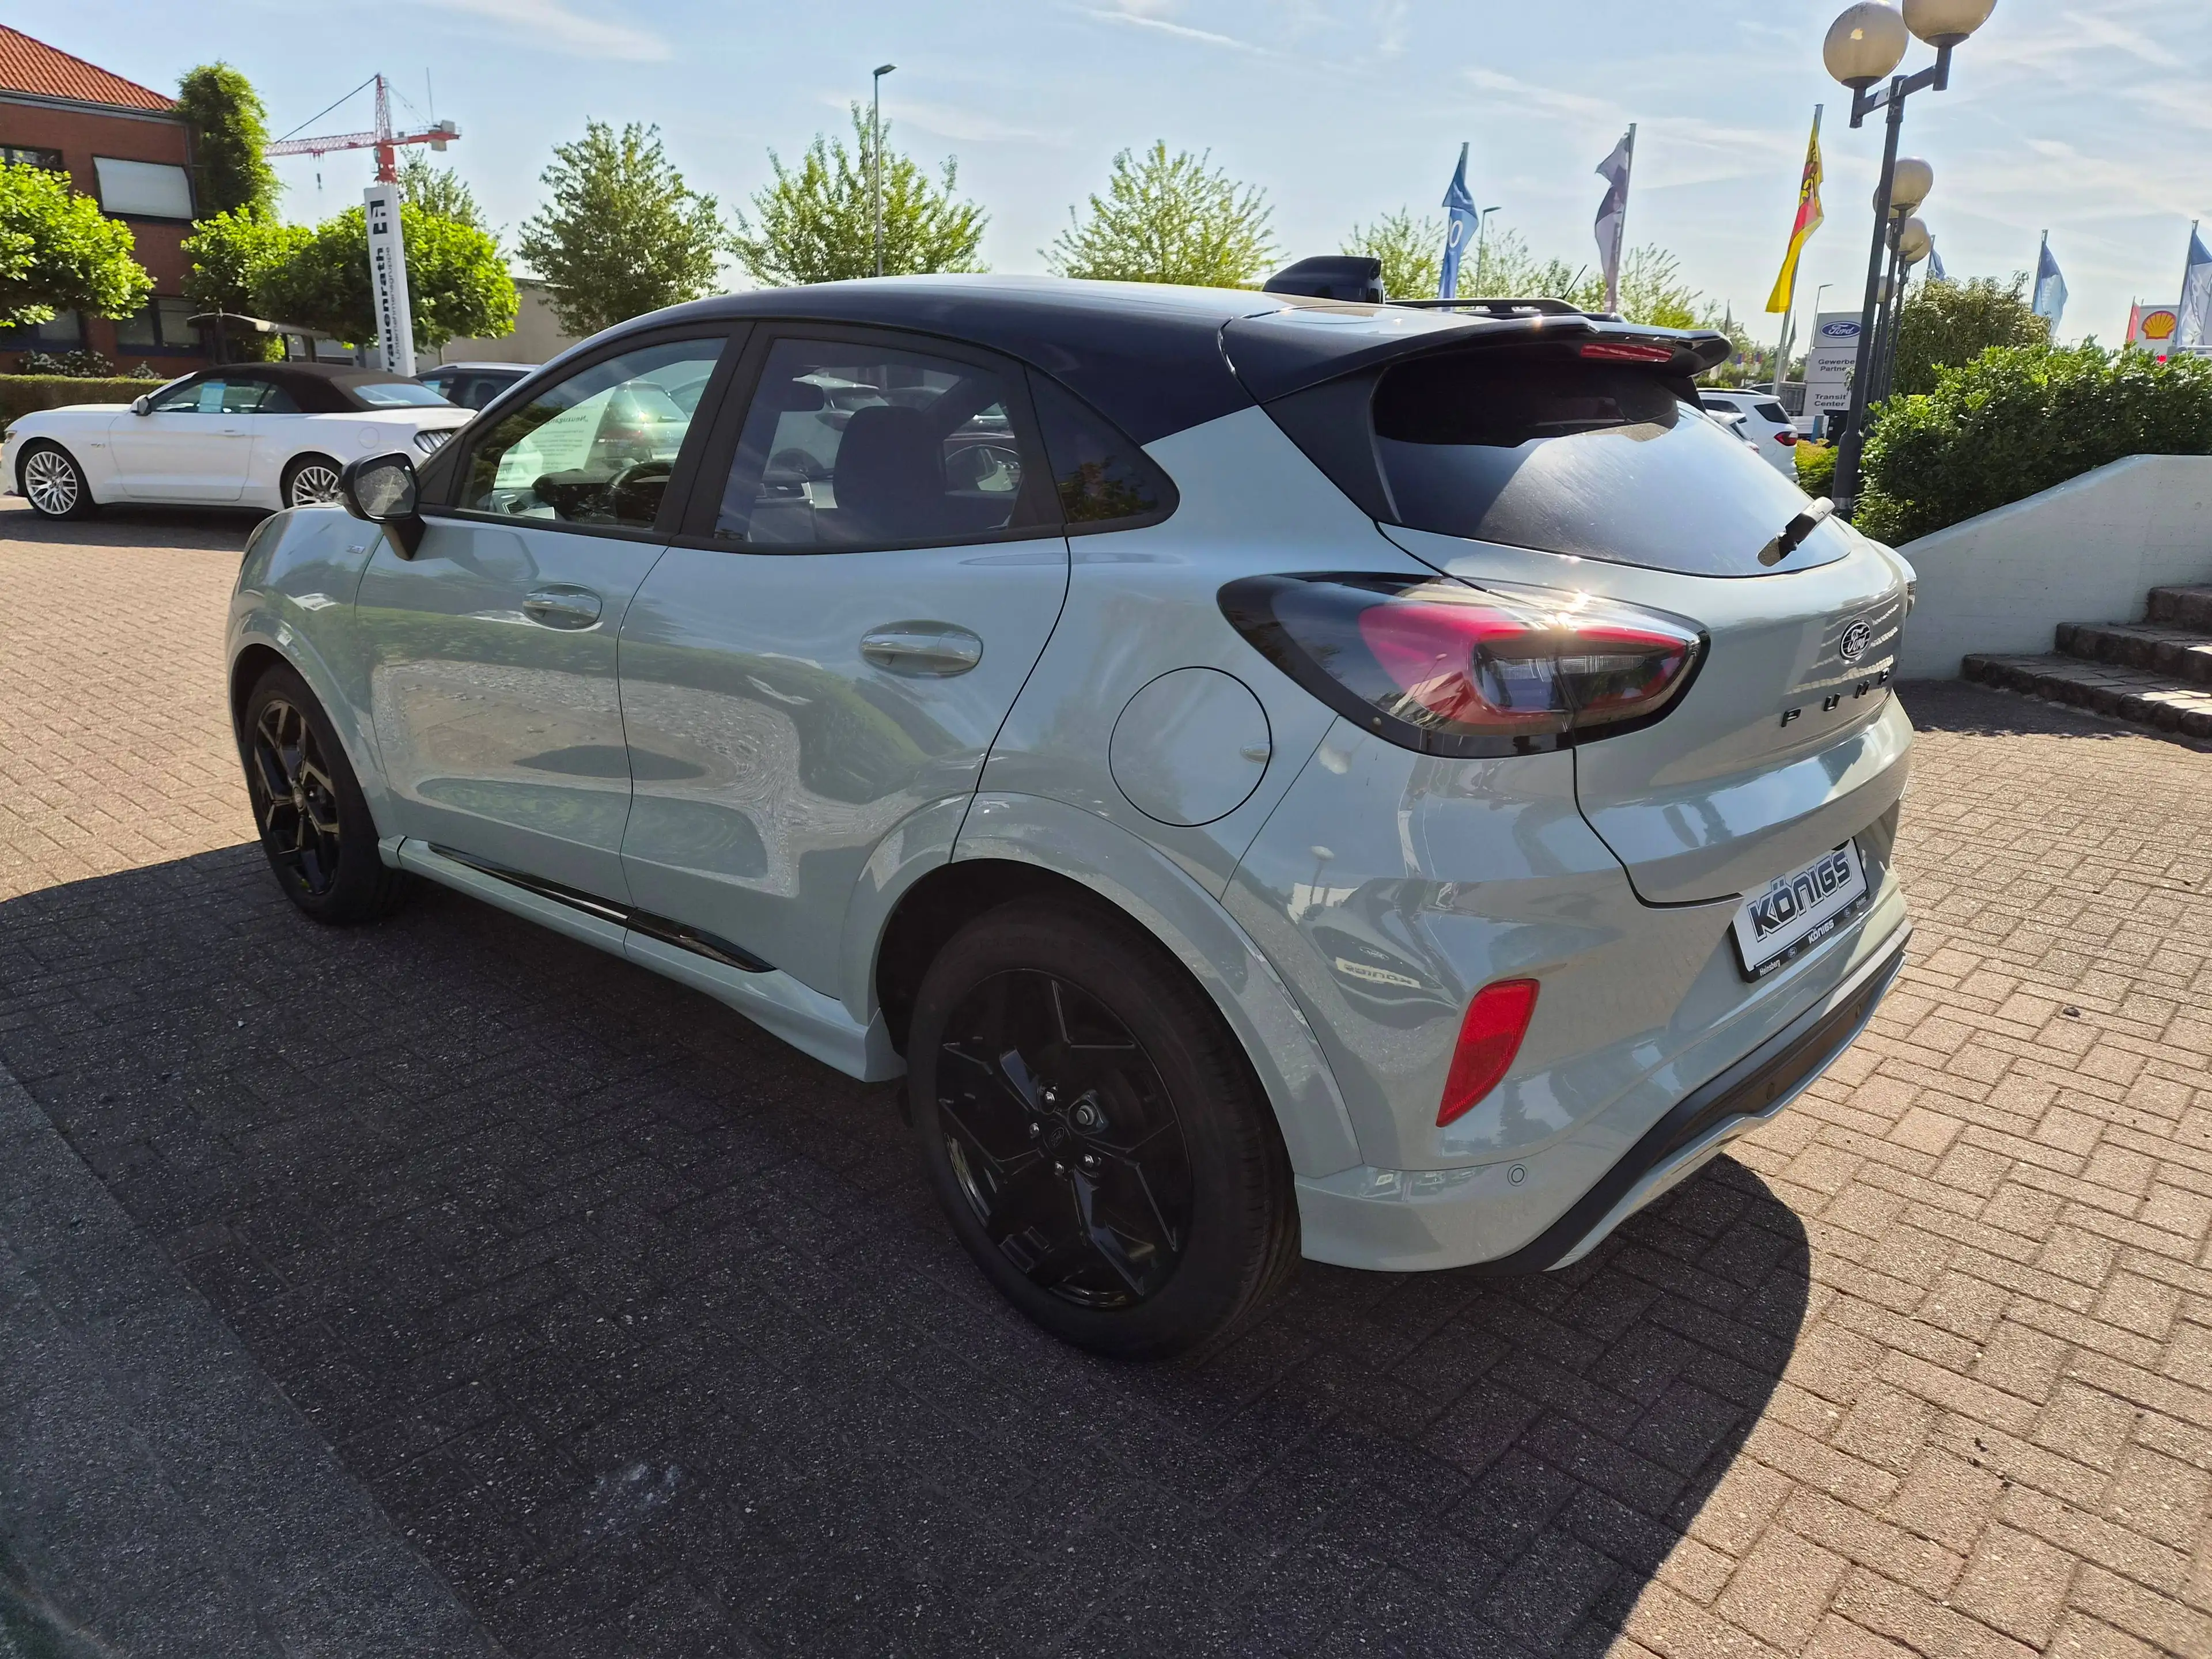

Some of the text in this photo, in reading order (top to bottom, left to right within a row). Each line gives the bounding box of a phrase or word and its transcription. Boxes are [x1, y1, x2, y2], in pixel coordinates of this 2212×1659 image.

[1747, 850, 1851, 942] KÖNIGS
[1760, 919, 1834, 976] Heinsberg KÖNIGS
